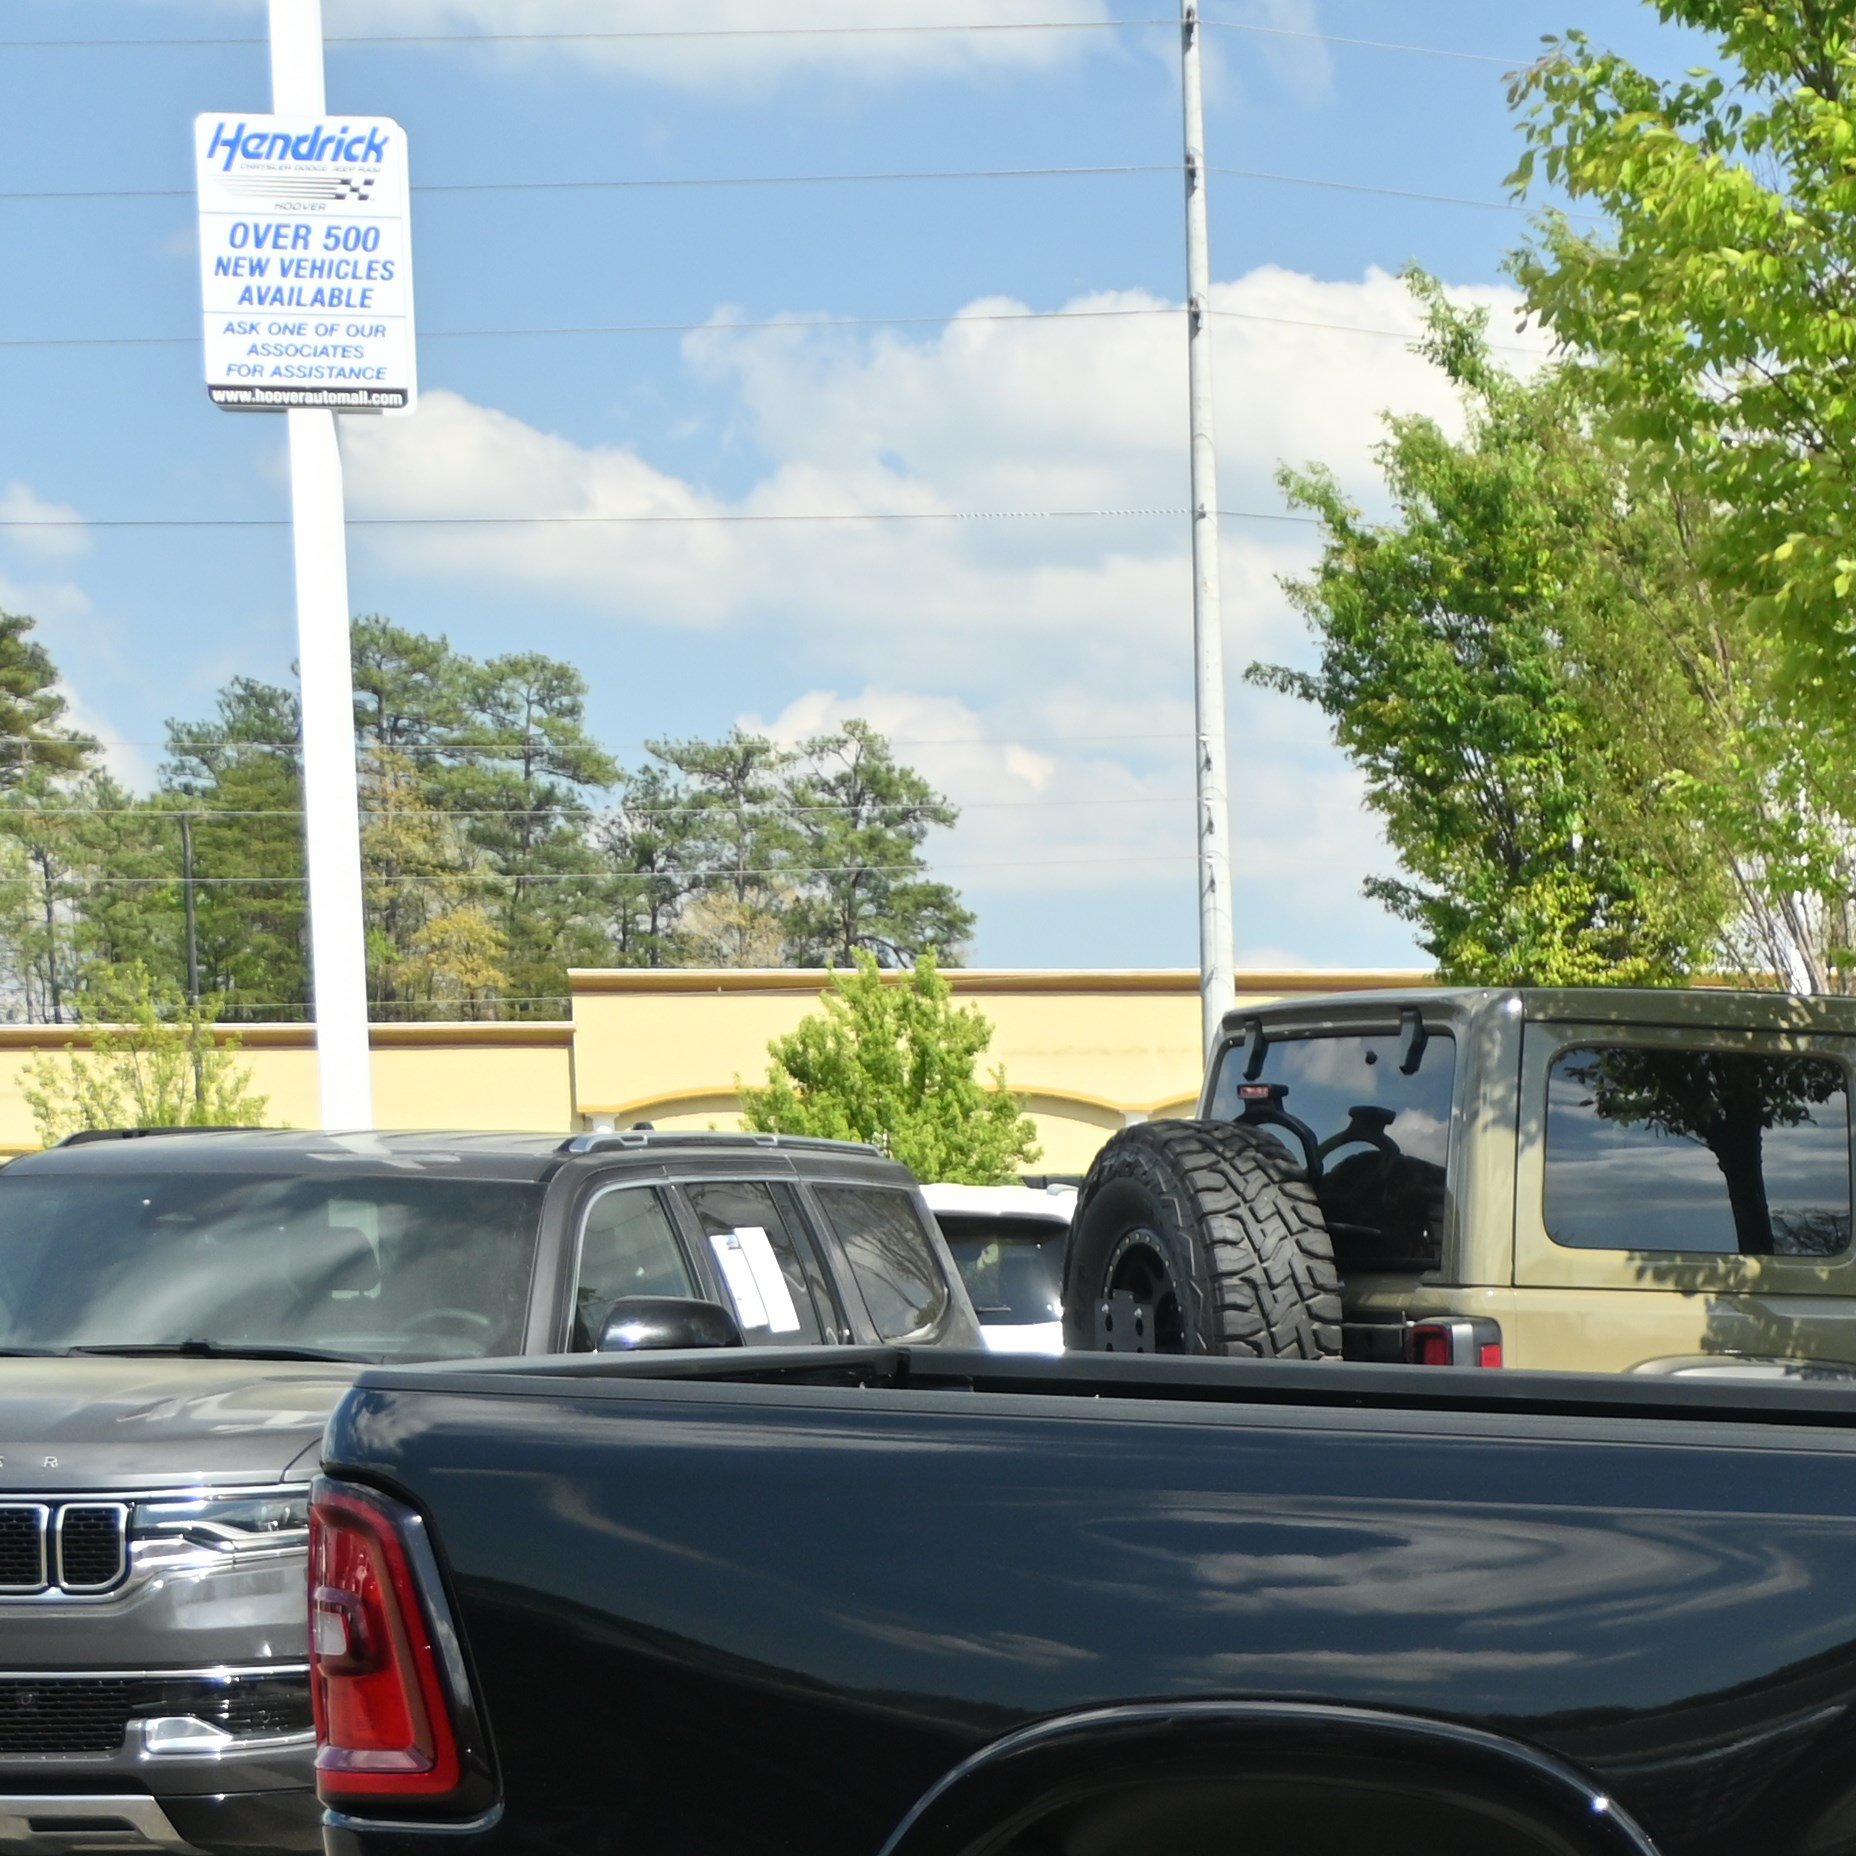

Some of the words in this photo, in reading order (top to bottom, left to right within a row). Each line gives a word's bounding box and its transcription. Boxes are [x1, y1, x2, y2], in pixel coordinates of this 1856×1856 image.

[206, 122, 390, 172] Hendrick
[274, 201, 327, 211] HOOVER
[229, 222, 312, 251] OVER
[323, 225, 380, 252] 500
[214, 255, 270, 278] NEW
[280, 257, 395, 281] VEHICLES
[237, 285, 375, 309] AVAILABLE
[223, 321, 260, 336] ASK
[268, 322, 307, 337] ONE
[314, 323, 339, 337] OF
[345, 324, 386, 338] OUR
[246, 343, 365, 359] ASSOCIATES
[226, 363, 264, 378] FOR
[270, 365, 387, 381] ASSISTANCE
[212, 388, 403, 406] www.hooverautomall.com
